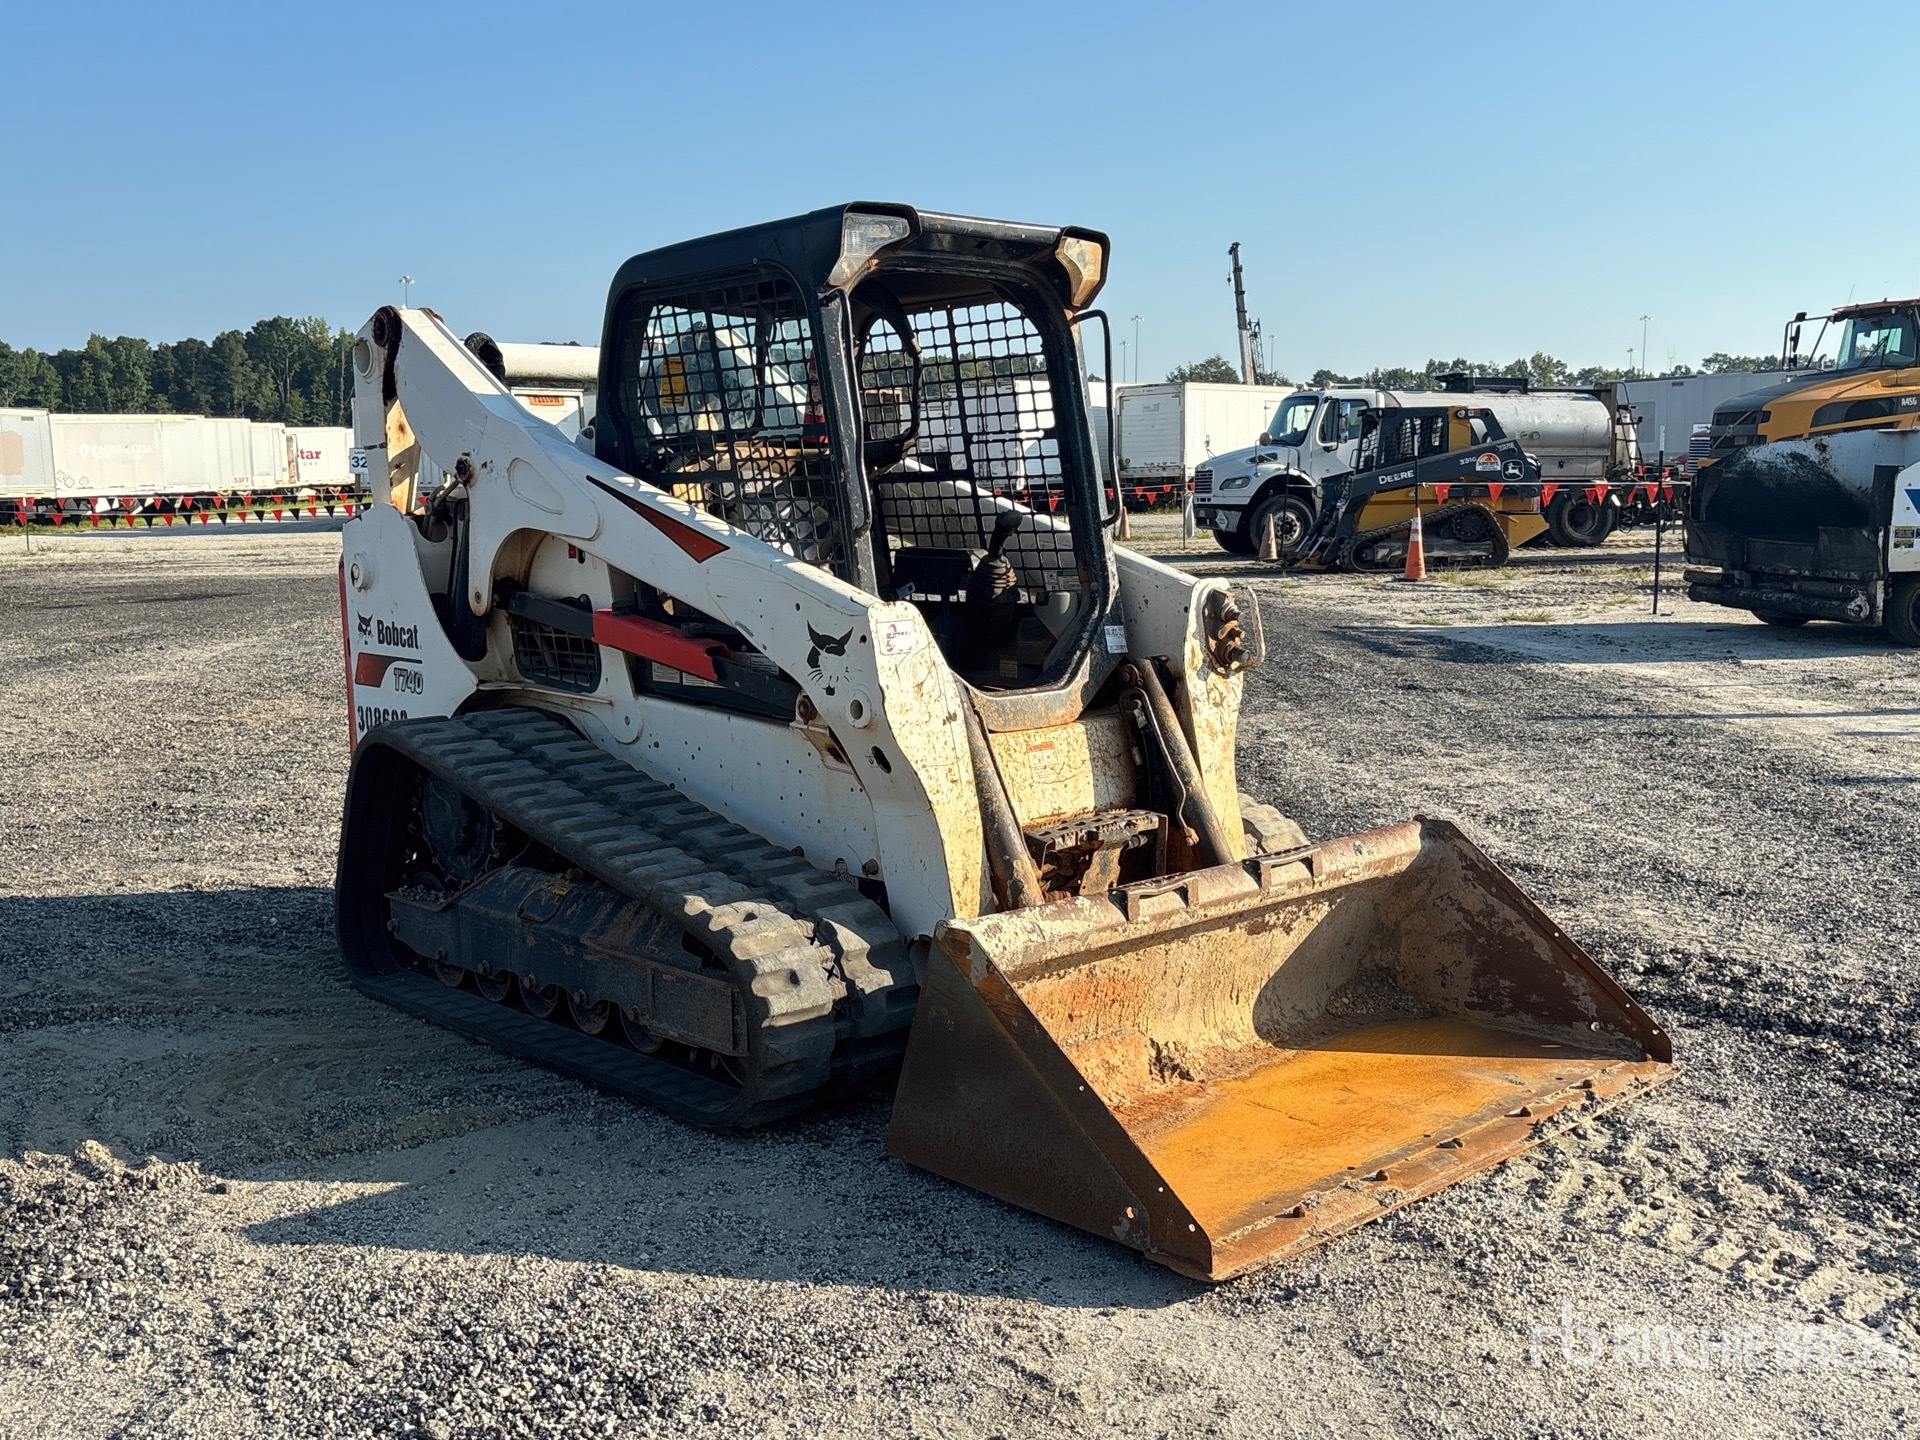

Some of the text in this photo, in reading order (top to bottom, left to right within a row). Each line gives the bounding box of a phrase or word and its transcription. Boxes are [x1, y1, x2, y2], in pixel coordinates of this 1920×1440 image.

[298, 448, 321, 460] tar
[351, 456, 368, 468] 32
[1378, 470, 1415, 485] DEERE
[376, 619, 419, 650] Bobcat
[393, 667, 424, 695] T740
